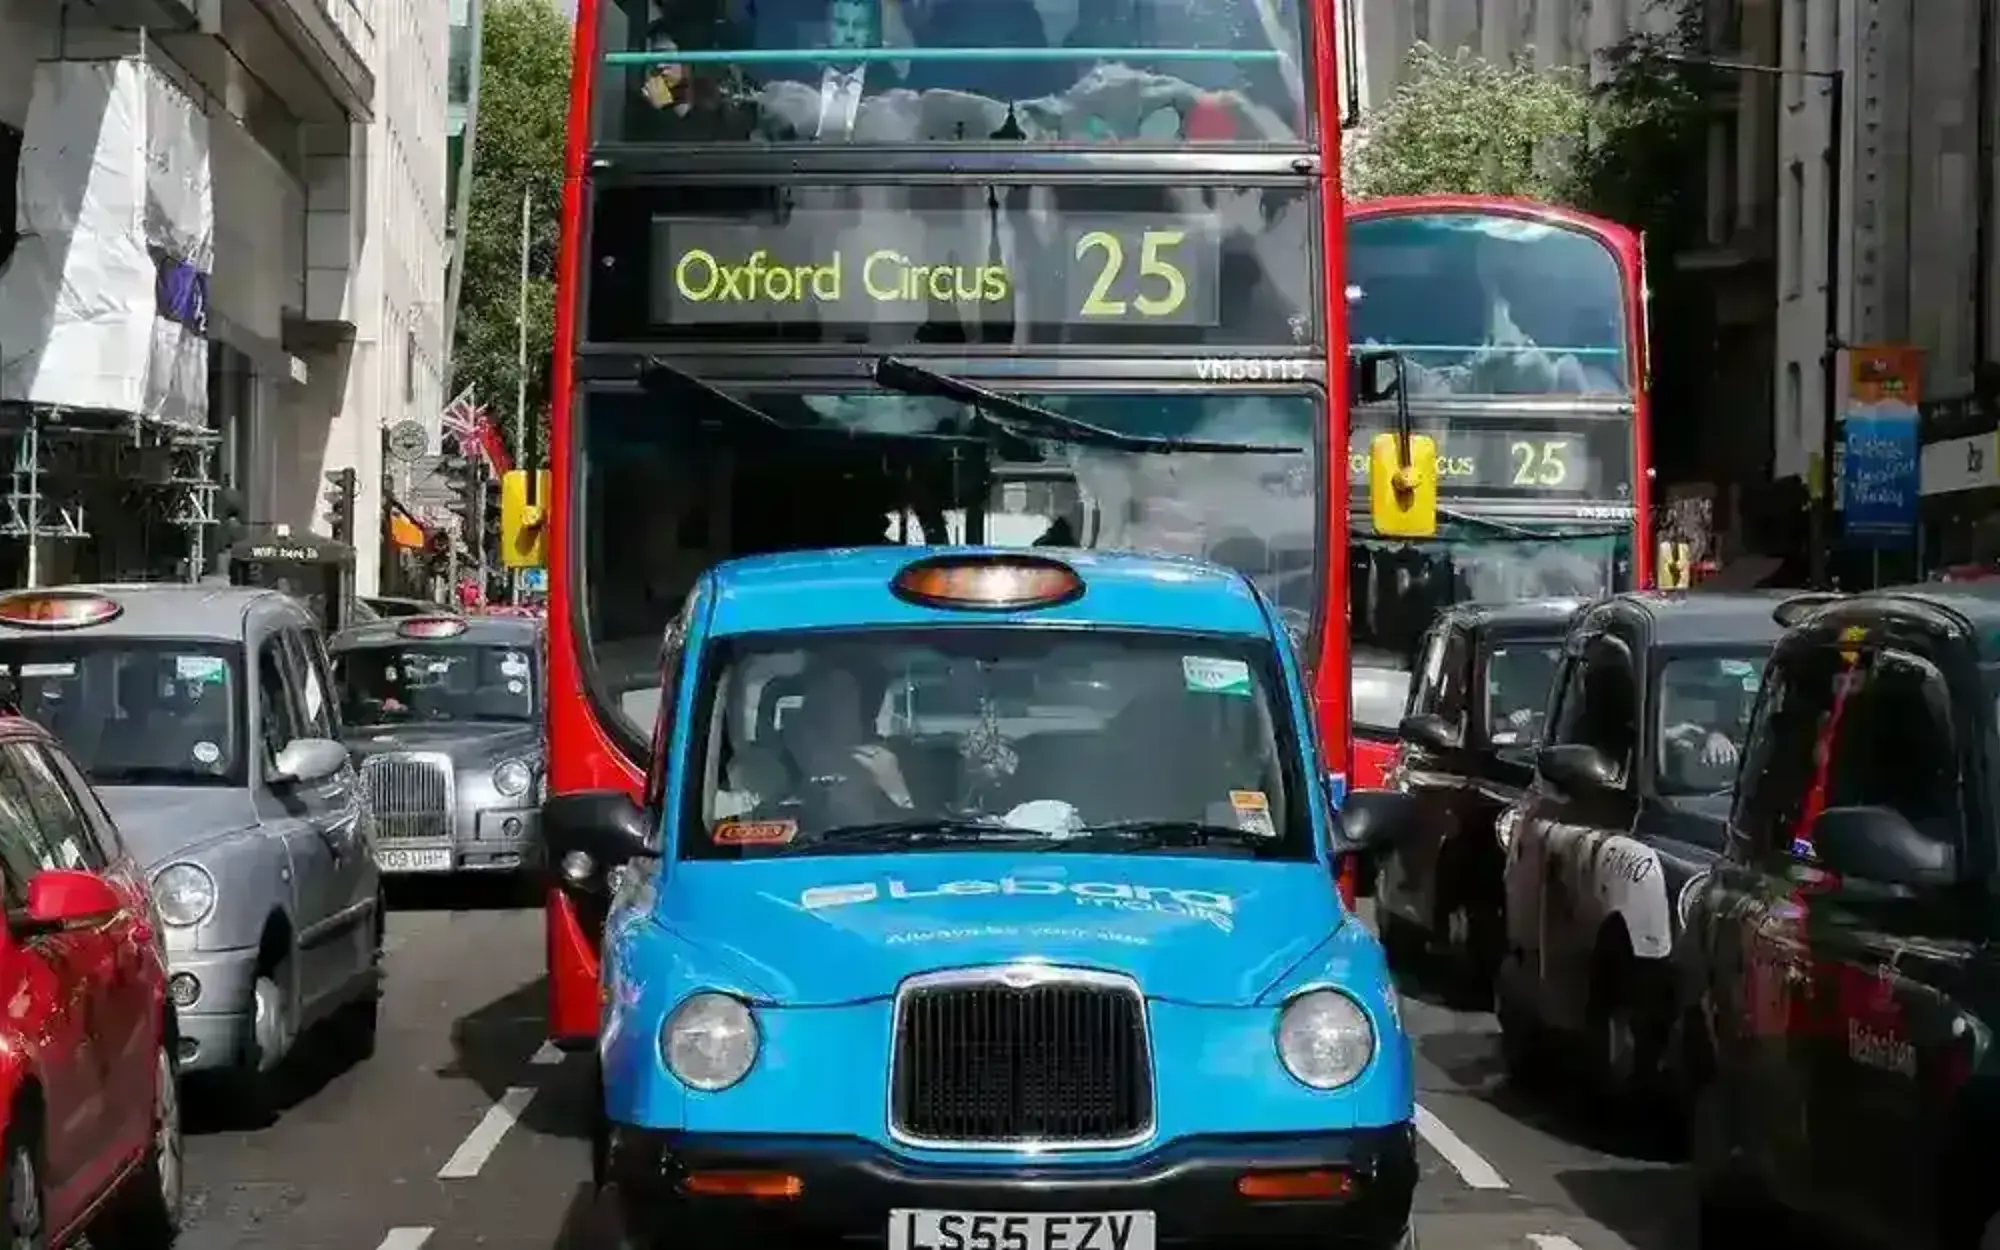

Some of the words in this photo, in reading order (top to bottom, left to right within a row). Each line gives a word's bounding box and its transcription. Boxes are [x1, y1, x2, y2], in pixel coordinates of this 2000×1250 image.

[675, 249, 841, 302] Oxford
[863, 249, 1008, 302] Circus
[1075, 231, 1187, 316] 25
[1511, 440, 1568, 486] 25
[1074, 894, 1236, 937] mobile
[906, 1213, 1031, 1250] LS55
